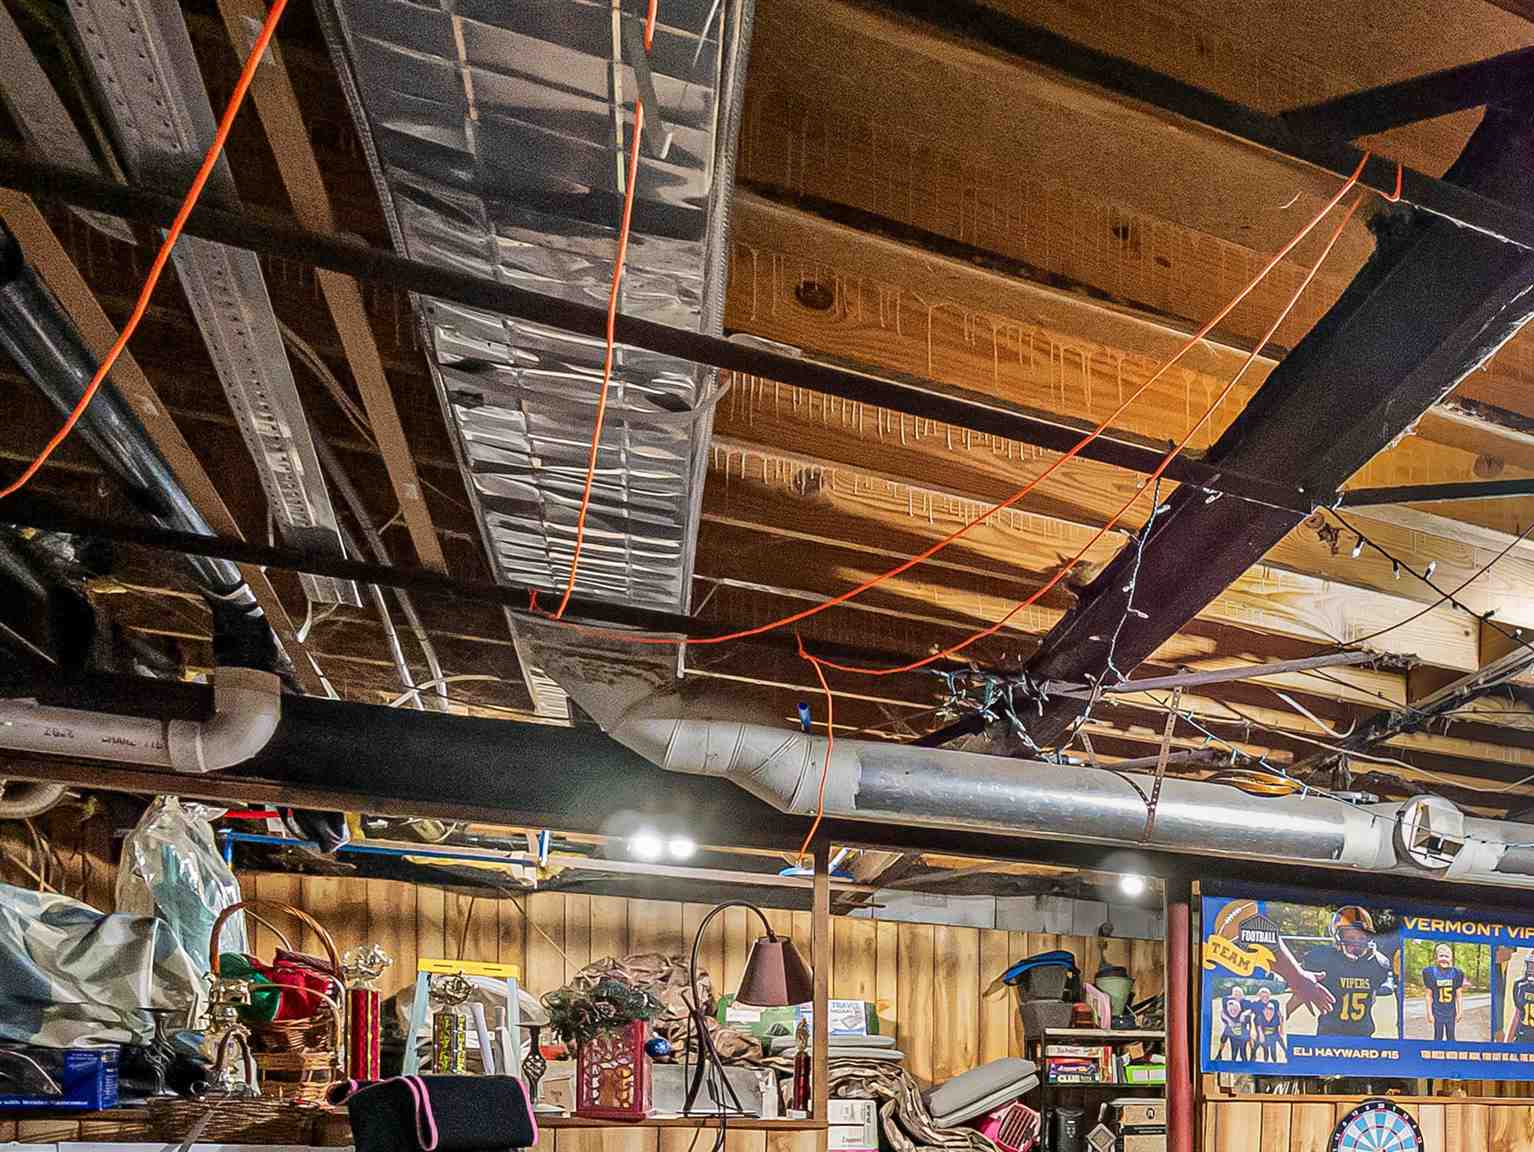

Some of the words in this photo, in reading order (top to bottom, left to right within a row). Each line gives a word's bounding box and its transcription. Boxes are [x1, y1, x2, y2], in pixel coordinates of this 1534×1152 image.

[1403, 916, 1504, 937] VERMONT
[1241, 930, 1277, 944] FOOTBALL
[1211, 942, 1249, 970] TEAM
[1340, 977, 1370, 990] VIPERS
[1439, 987, 1453, 1003] 15
[1339, 992, 1369, 1021] 15
[1293, 1046, 1313, 1057] ELI
[1315, 1048, 1379, 1060] HAYWARD
[1381, 1051, 1400, 1060] #15
